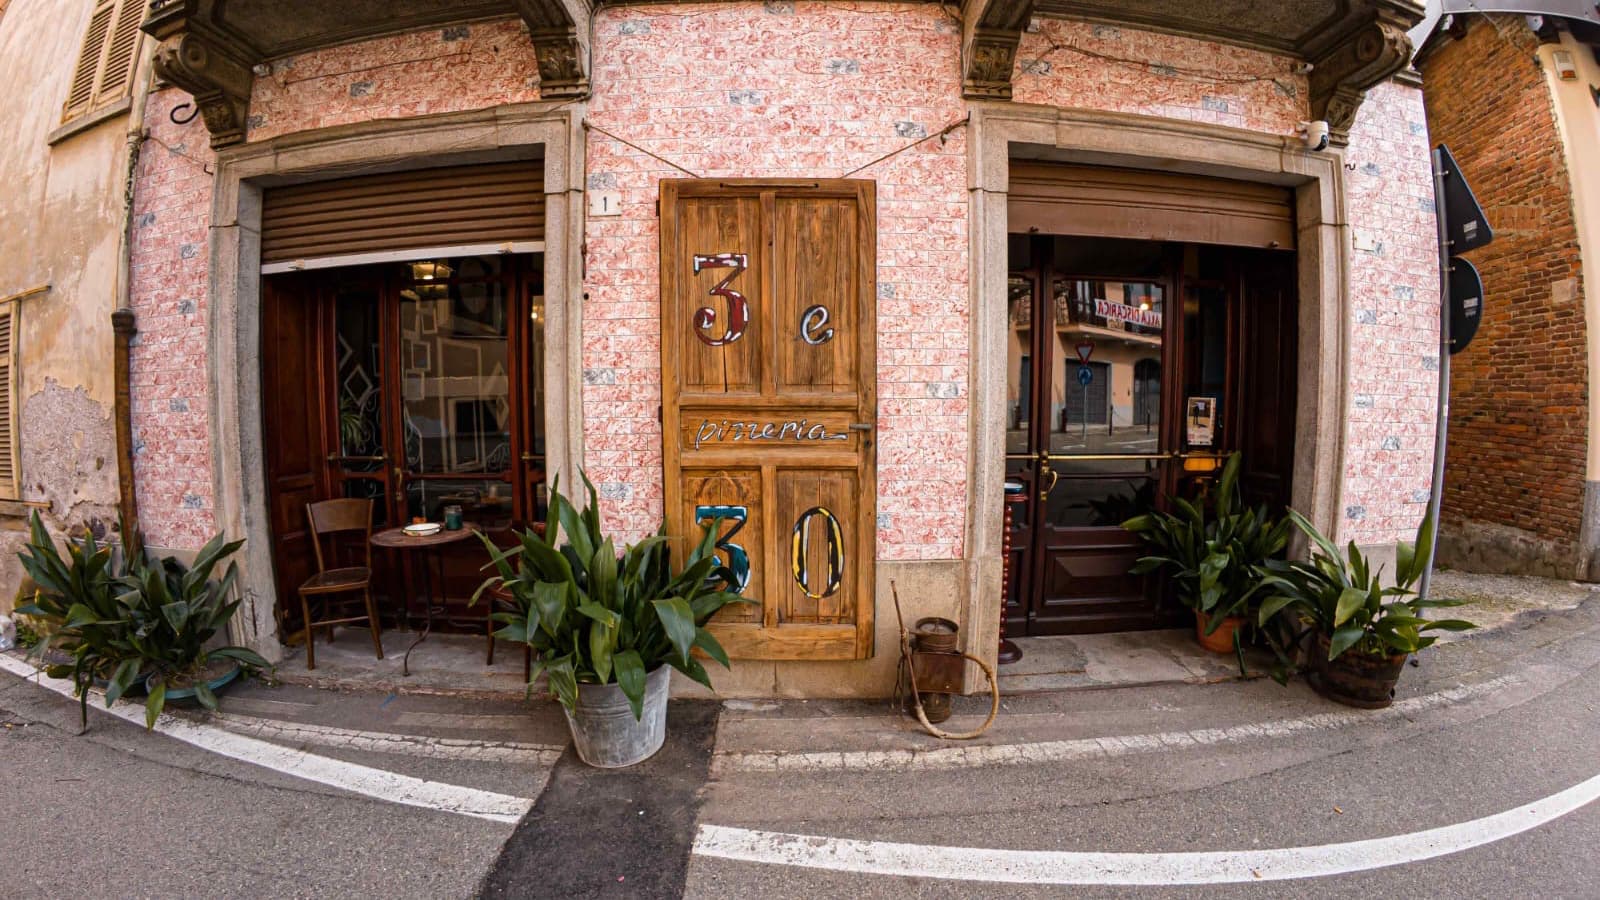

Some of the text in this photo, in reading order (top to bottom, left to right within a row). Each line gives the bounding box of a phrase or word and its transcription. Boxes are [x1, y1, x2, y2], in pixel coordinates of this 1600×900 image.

[603, 196, 607, 212] 1
[693, 254, 834, 346] 3 e
[695, 419, 848, 450] pizzeria
